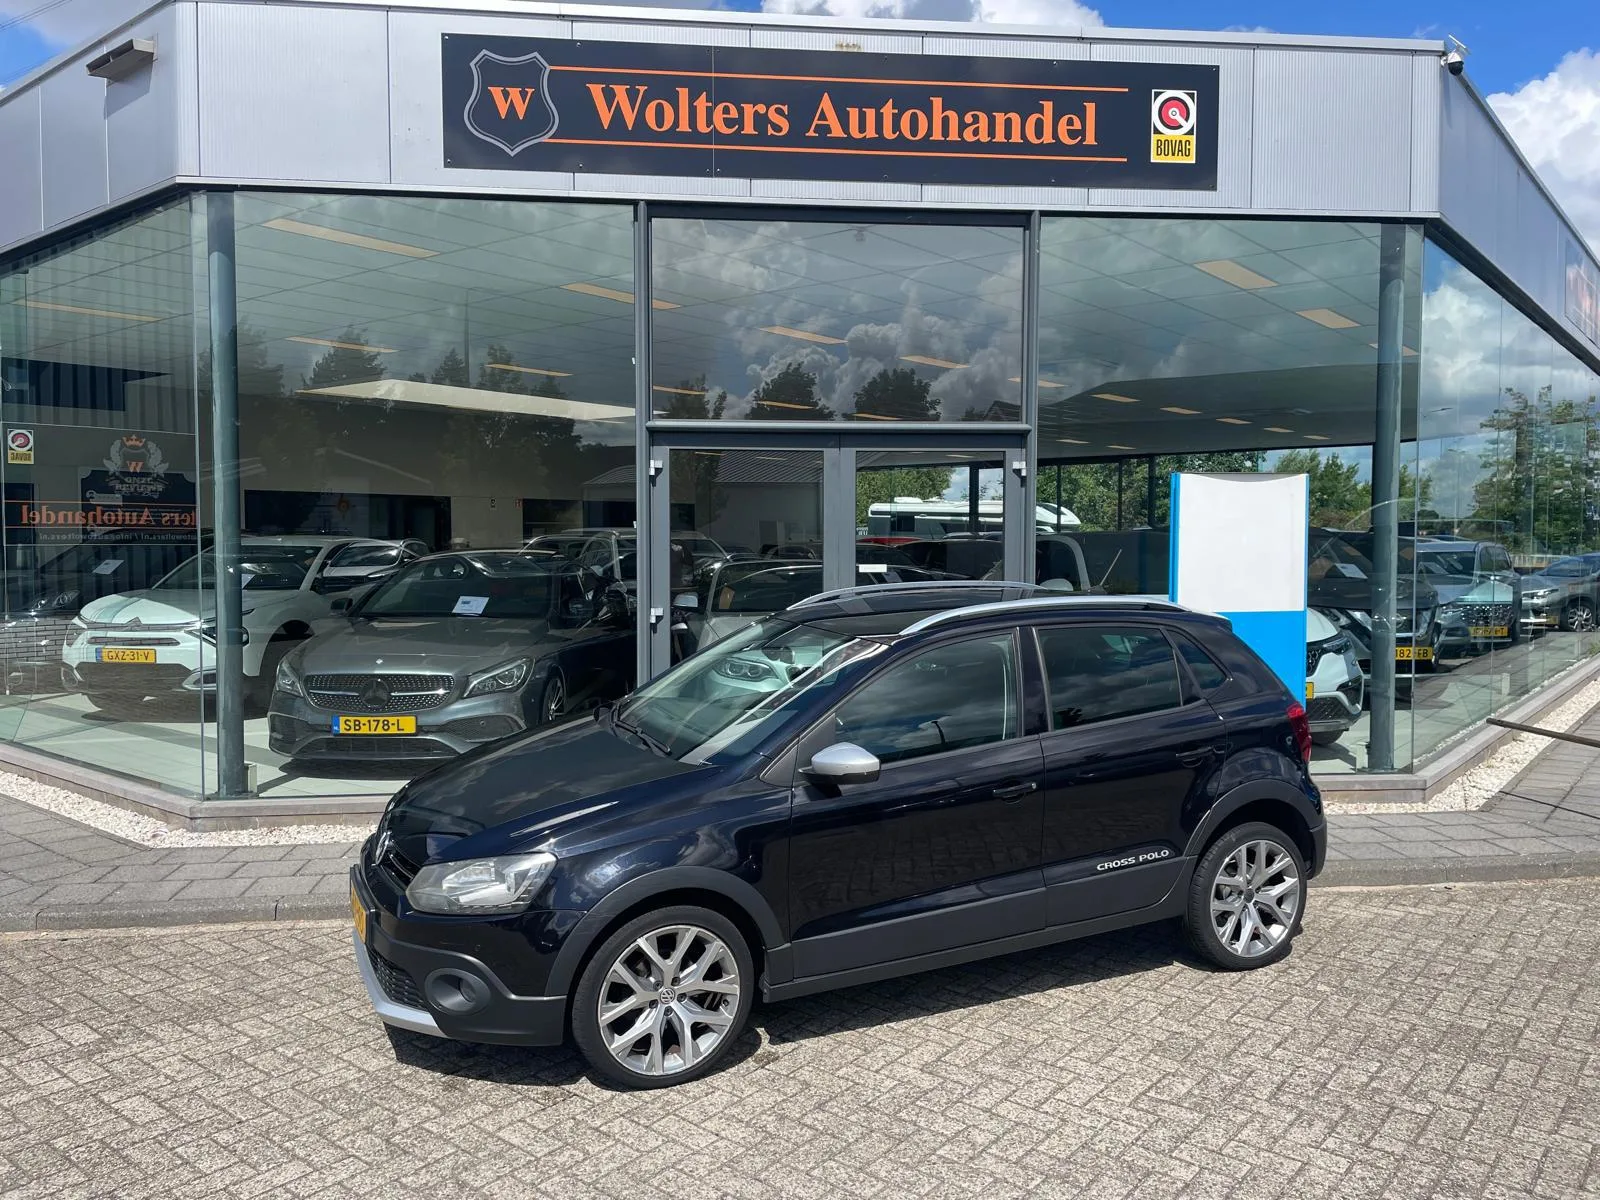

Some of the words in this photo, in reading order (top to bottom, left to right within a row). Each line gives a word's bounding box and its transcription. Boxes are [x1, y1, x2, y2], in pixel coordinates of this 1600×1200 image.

[487, 86, 536, 120] W
[585, 83, 790, 137] Wolters
[805, 91, 1098, 145] Autohandel
[1156, 139, 1191, 157] BOVAG
[107, 650, 150, 661] GXZ-31-V
[1396, 649, 1428, 658] 182-FB
[343, 719, 405, 732] SB-178-L
[1096, 857, 1136, 871] CROSS
[1139, 849, 1170, 862] POLO
